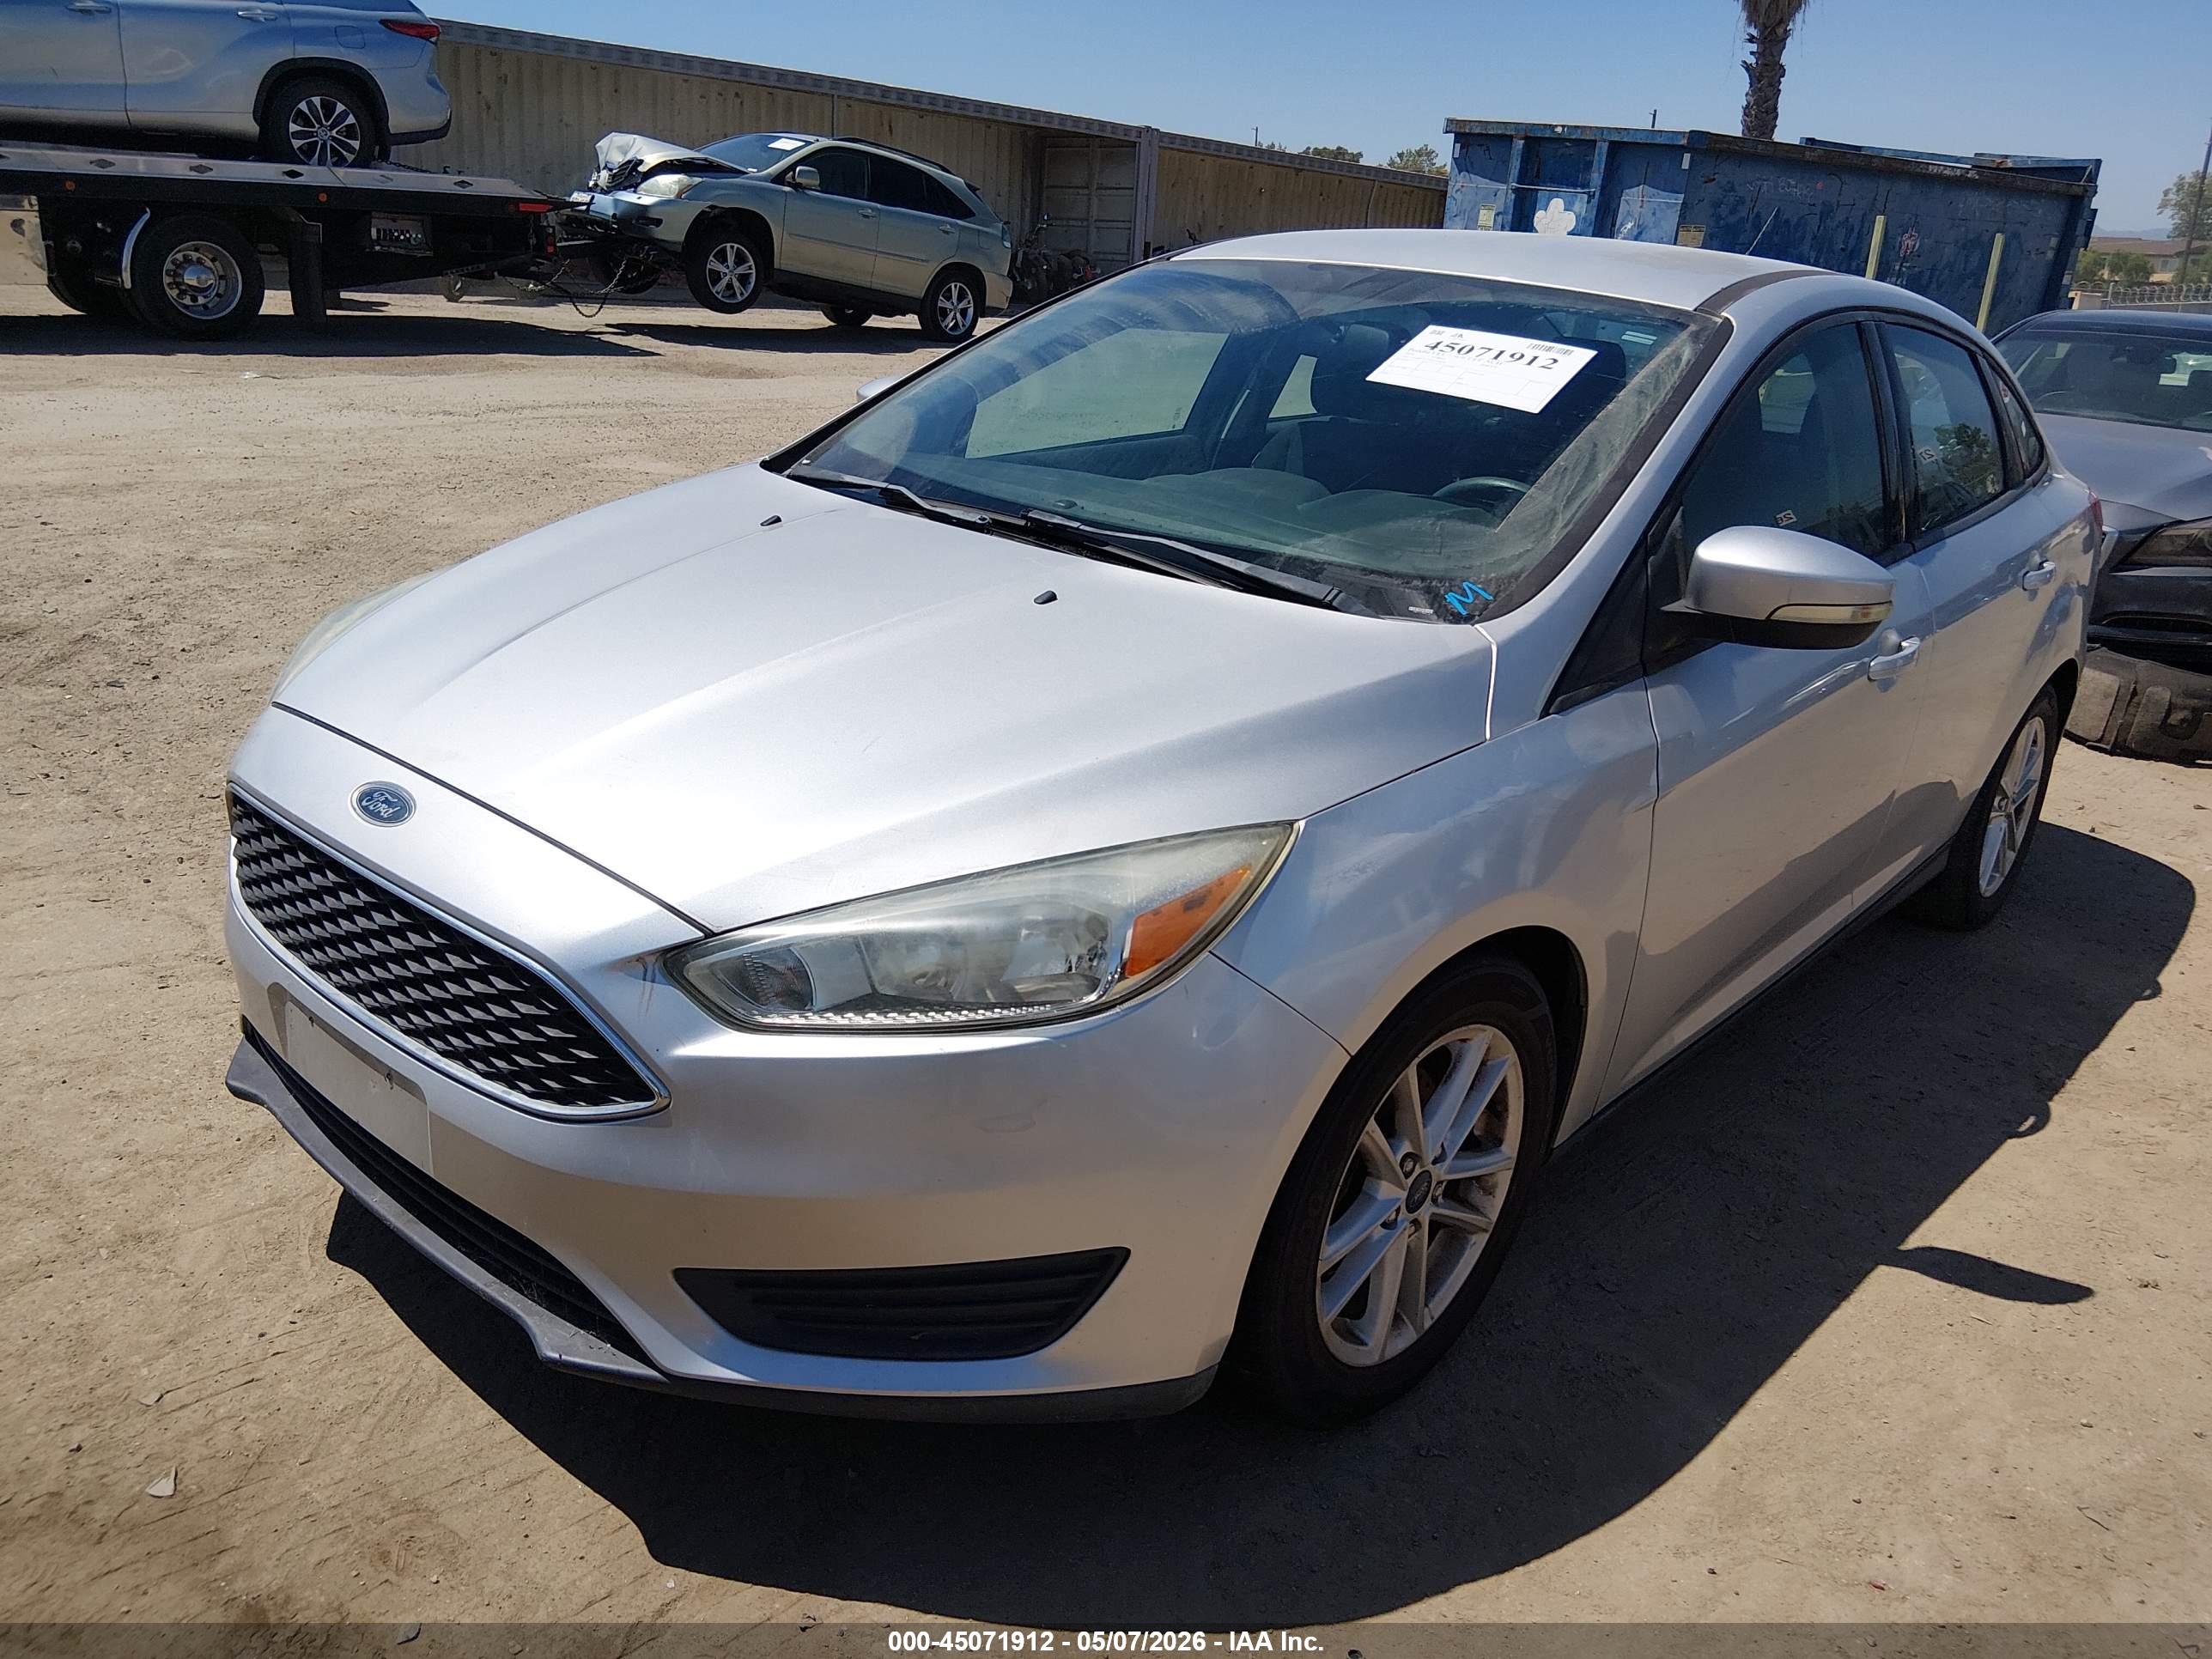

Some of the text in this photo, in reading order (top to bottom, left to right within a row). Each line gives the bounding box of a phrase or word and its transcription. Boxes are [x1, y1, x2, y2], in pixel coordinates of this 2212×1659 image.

[1425, 341, 1559, 369] 45071912
[1444, 581, 1493, 615] M
[362, 791, 401, 817] Ford
